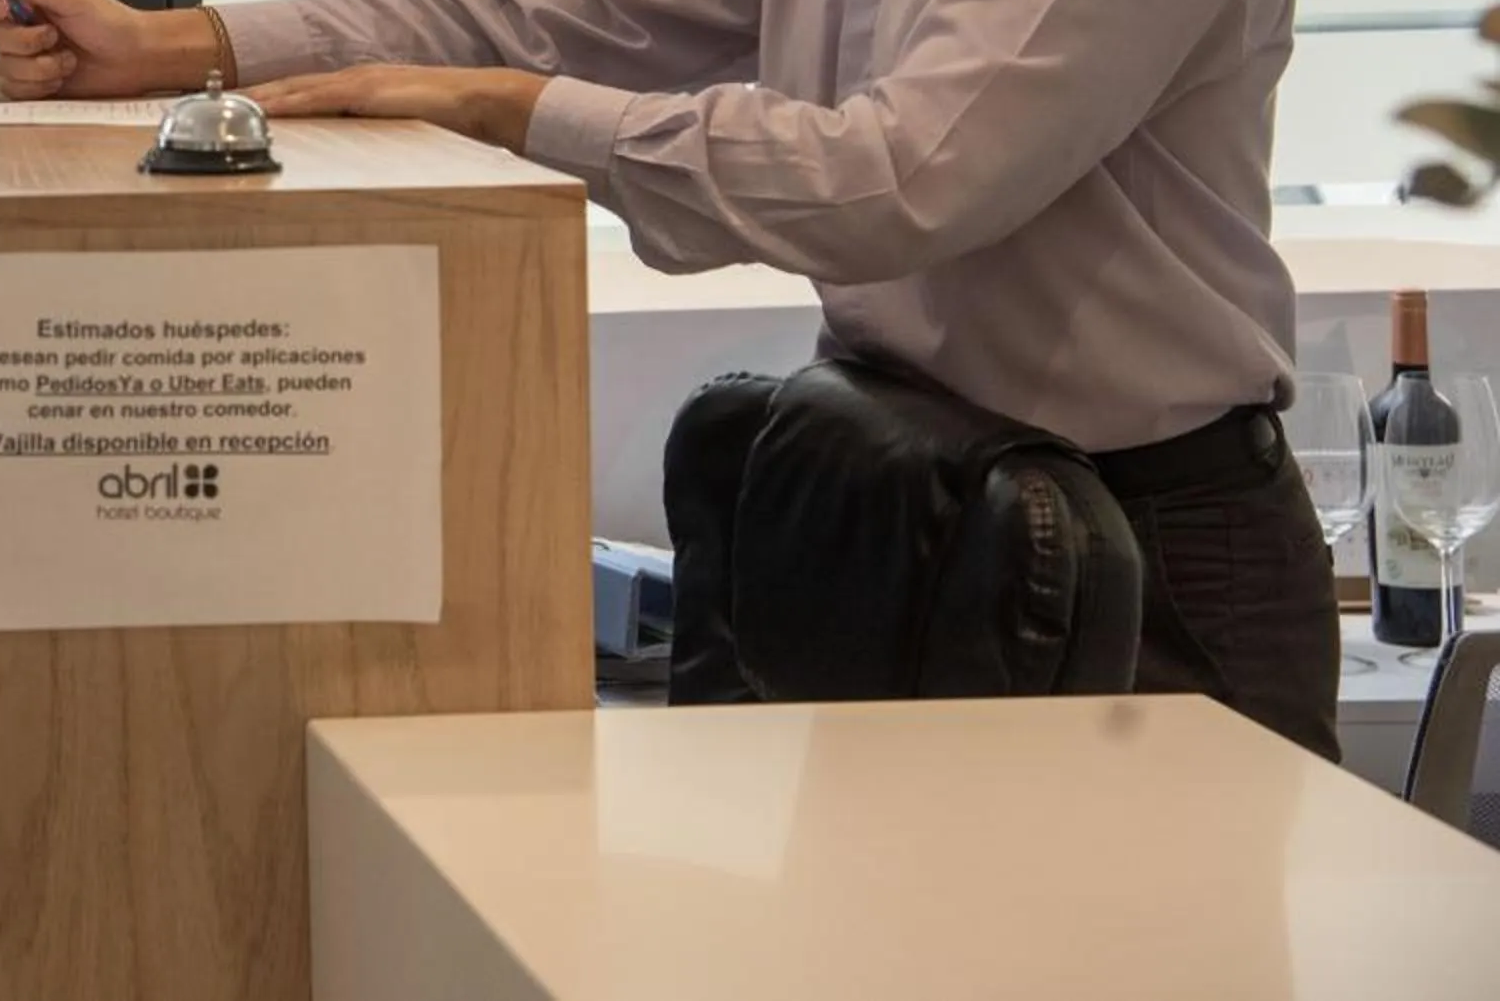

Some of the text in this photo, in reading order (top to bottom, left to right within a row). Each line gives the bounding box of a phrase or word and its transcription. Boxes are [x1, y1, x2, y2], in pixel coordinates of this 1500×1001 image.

[37, 319, 290, 342] Estimados huéspedes:
[64, 349, 116, 370] pedir
[122, 349, 195, 366] comida
[202, 351, 235, 369] por
[240, 348, 366, 369] aplicaciones
[35, 374, 144, 395] PedidosYa
[149, 378, 163, 393] o
[168, 374, 216, 393] Uber
[277, 374, 352, 394] pueden
[28, 403, 83, 419] cenar
[89, 403, 114, 419] en
[120, 400, 197, 419] nuestro
[61, 432, 179, 455] disponible
[185, 434, 212, 450] en
[98, 463, 178, 499] abril
[96, 504, 223, 522] hotel boutique
